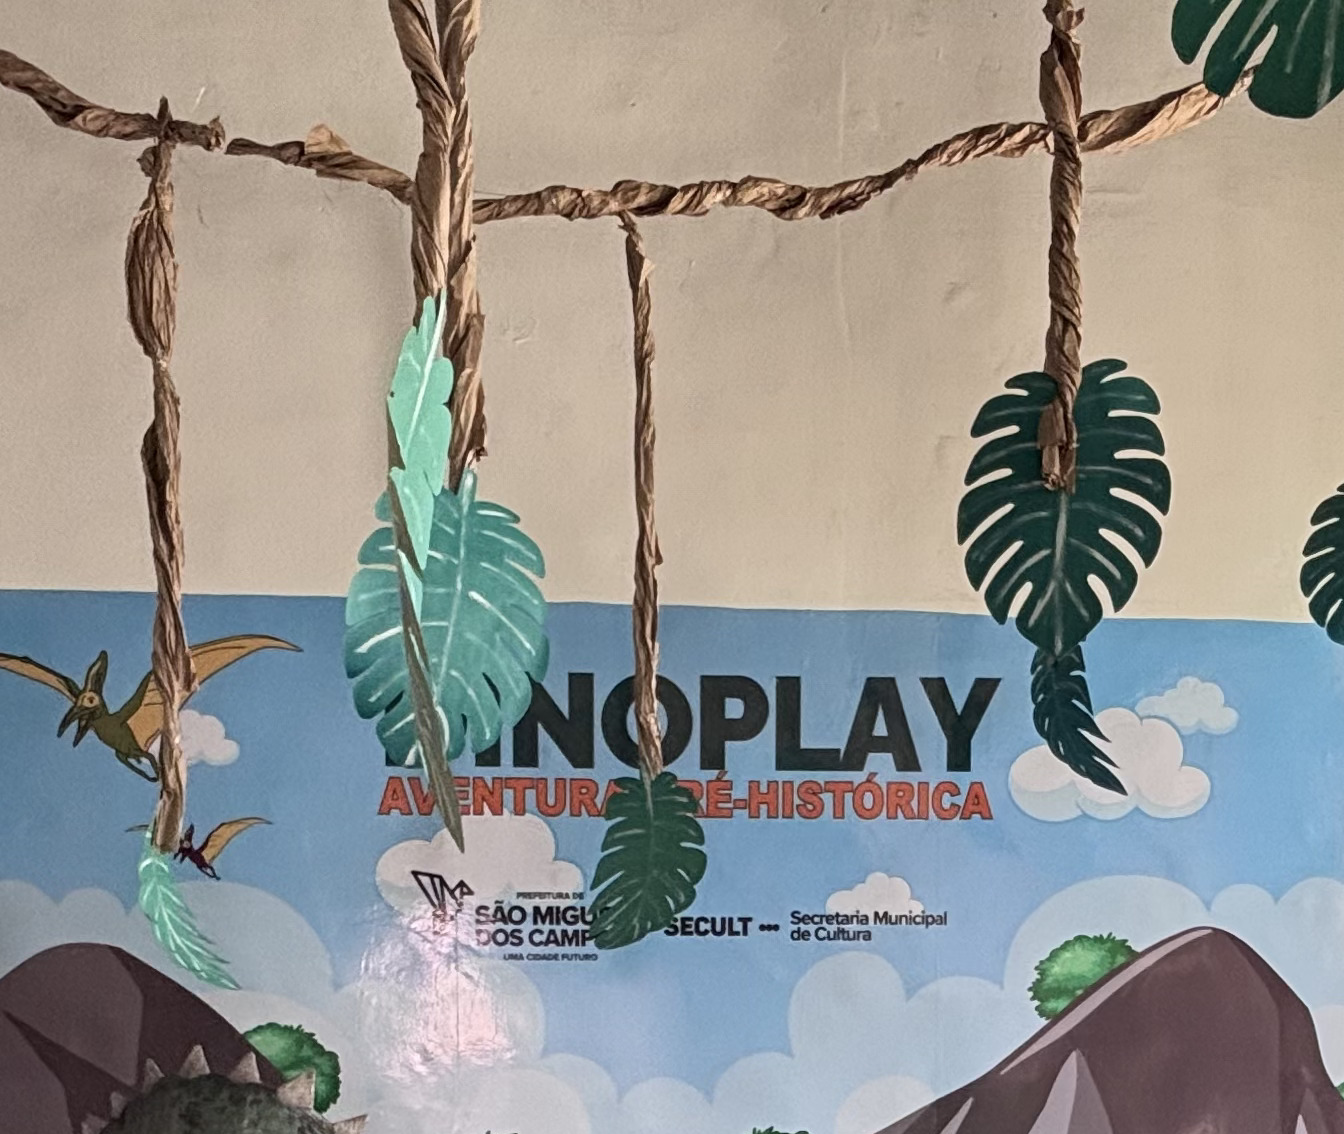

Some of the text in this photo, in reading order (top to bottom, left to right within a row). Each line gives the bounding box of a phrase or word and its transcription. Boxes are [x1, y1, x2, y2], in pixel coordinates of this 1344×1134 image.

[385, 672, 1002, 772] NOPLAY
[674, 769, 994, 820] É-HISTÓRICA
[475, 900, 602, 926] SÃO MIGU
[789, 910, 948, 928] Secretaria Municipal
[663, 916, 753, 937] SECULT
[789, 926, 872, 942] de Cultura
[475, 928, 594, 947] DOS CAMP
